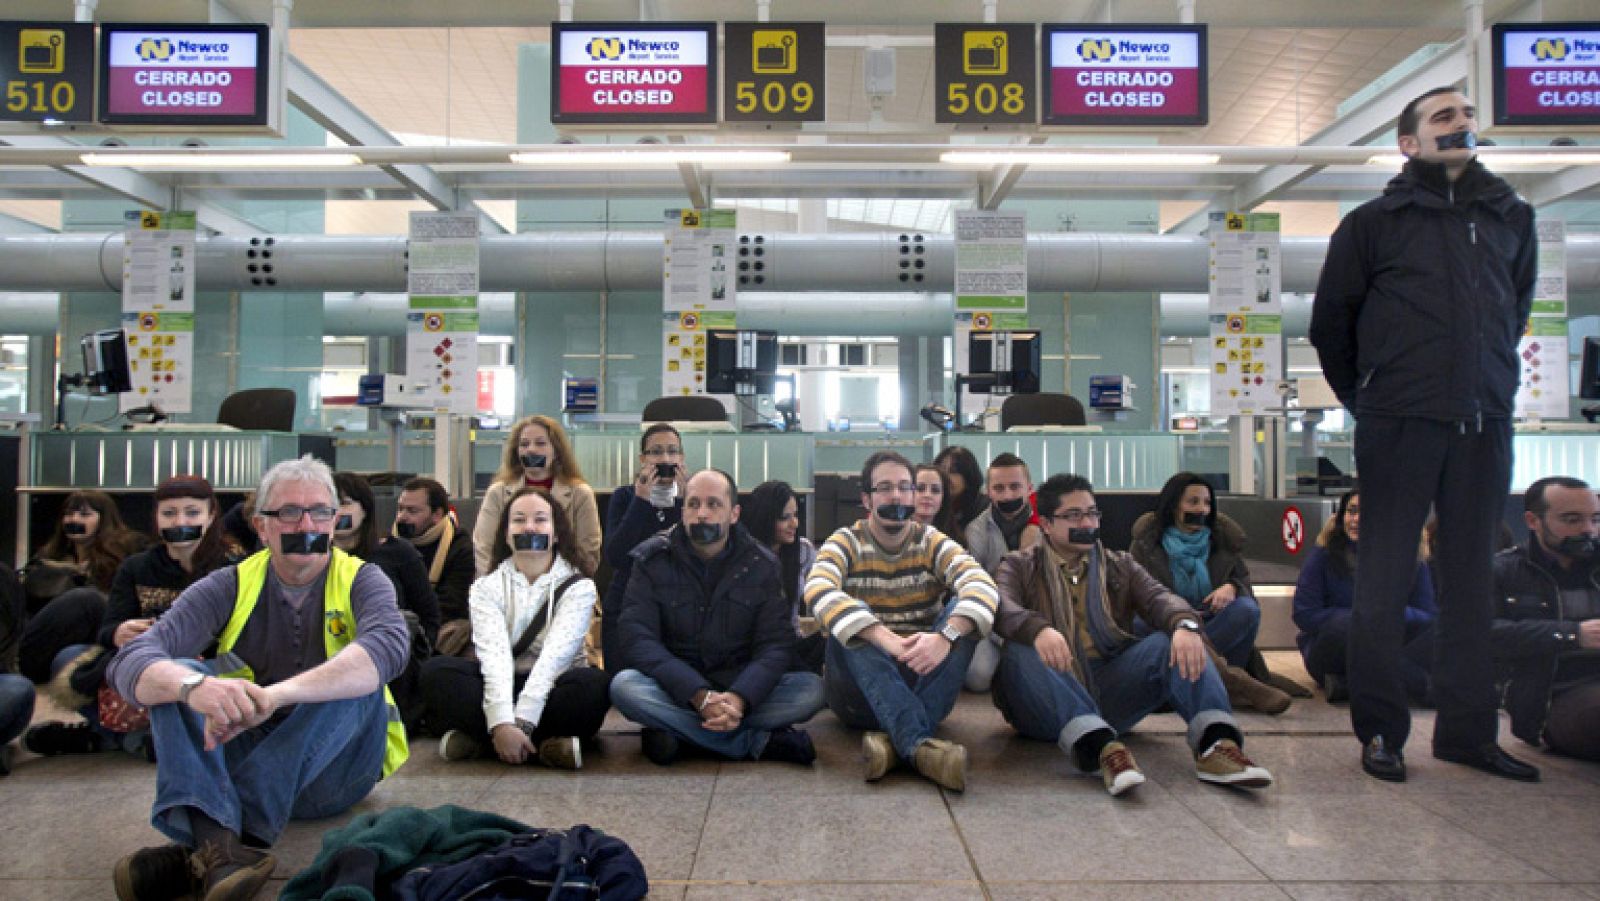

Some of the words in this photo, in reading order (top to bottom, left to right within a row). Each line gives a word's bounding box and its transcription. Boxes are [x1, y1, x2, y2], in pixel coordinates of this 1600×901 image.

[178, 39, 230, 53] Newco
[628, 38, 680, 51] Newco
[1118, 39, 1170, 53] Newco
[134, 70, 232, 86] CERRADO
[584, 69, 682, 85] CERRADO
[1076, 71, 1174, 86] CERRADO
[6, 81, 75, 113] 510
[141, 91, 223, 107] CLOSED
[592, 89, 675, 105] CLOSED
[735, 81, 815, 113] 509
[947, 82, 1025, 115] 508
[1084, 91, 1166, 107] CLOSED
